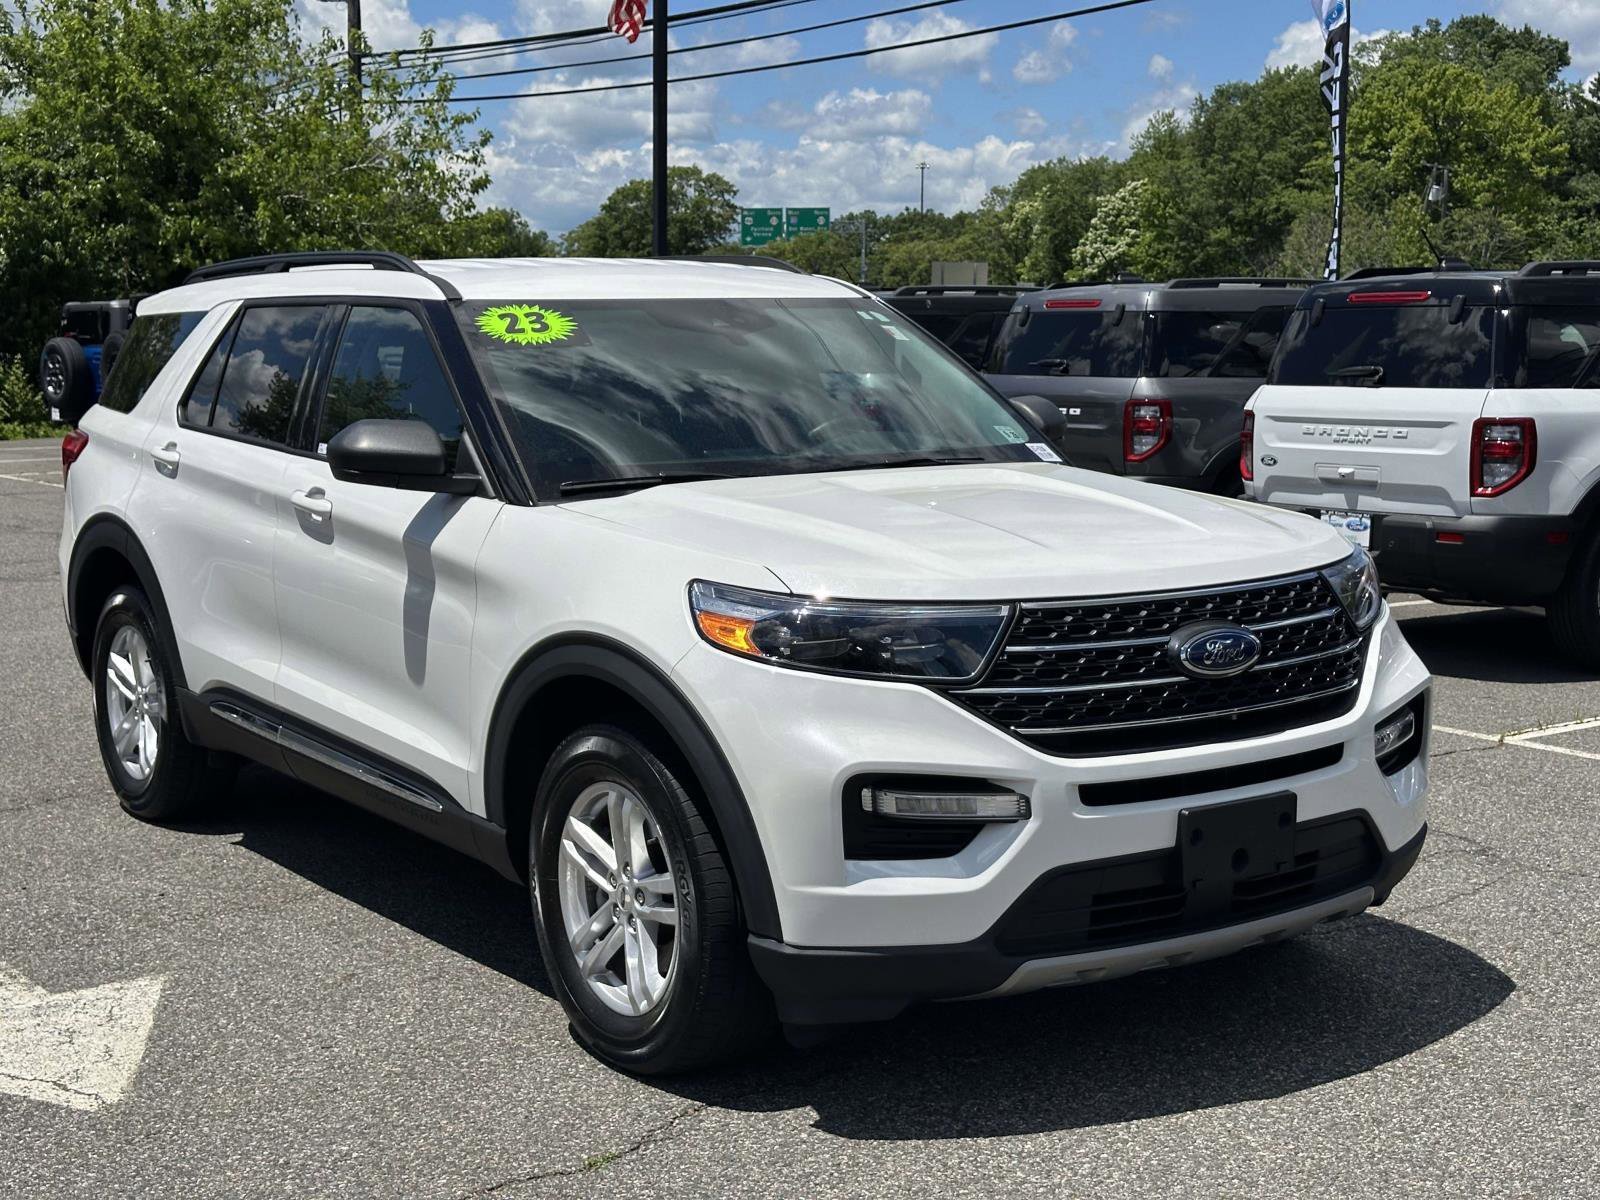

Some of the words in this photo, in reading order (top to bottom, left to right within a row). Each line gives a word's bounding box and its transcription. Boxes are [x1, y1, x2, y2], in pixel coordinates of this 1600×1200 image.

[497, 311, 551, 334] 23
[1302, 425, 1409, 439] BRONCO
[1333, 437, 1371, 445] SPORT
[1203, 638, 1245, 665] Ford
